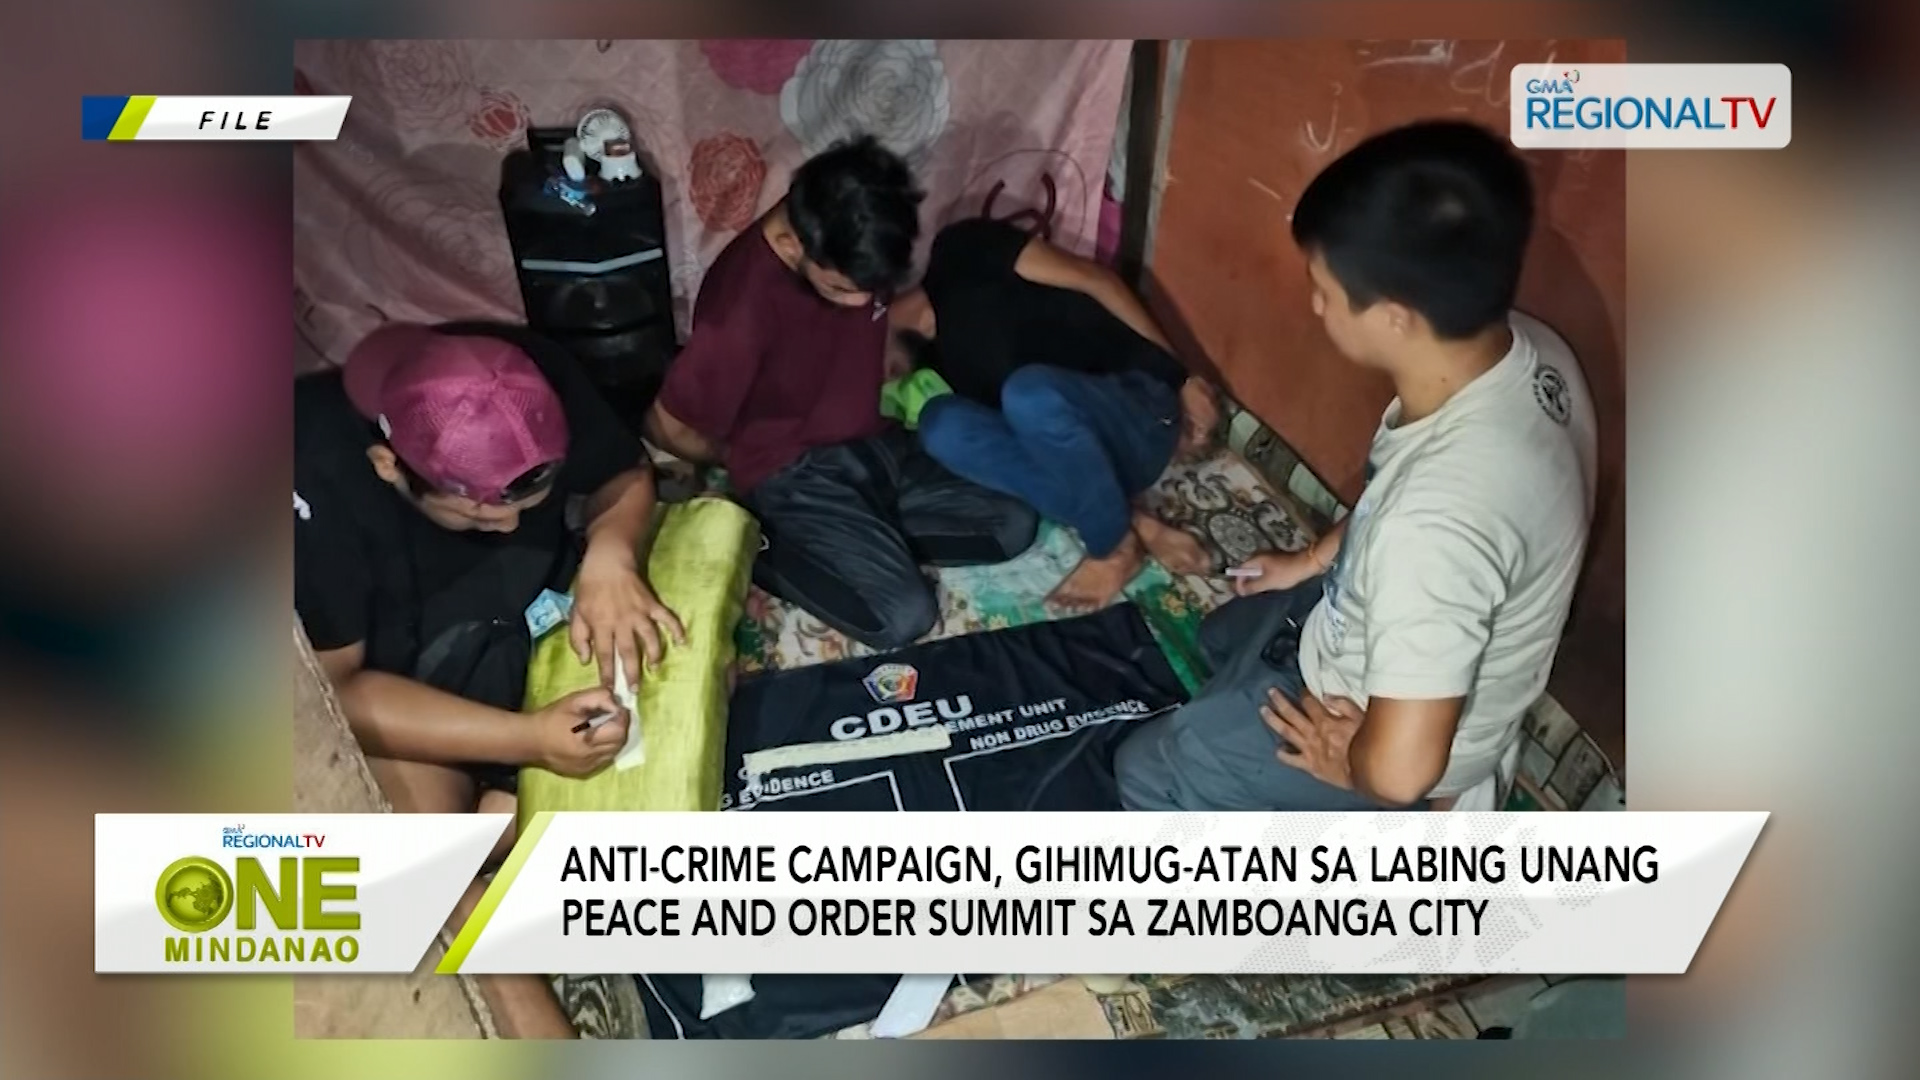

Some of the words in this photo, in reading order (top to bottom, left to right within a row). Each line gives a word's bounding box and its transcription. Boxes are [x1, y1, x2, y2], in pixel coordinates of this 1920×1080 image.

[830, 694, 974, 741] CDEU
[1018, 698, 1067, 719] UNIT
[969, 730, 1012, 751] NON
[1013, 718, 1064, 741] DRUG
